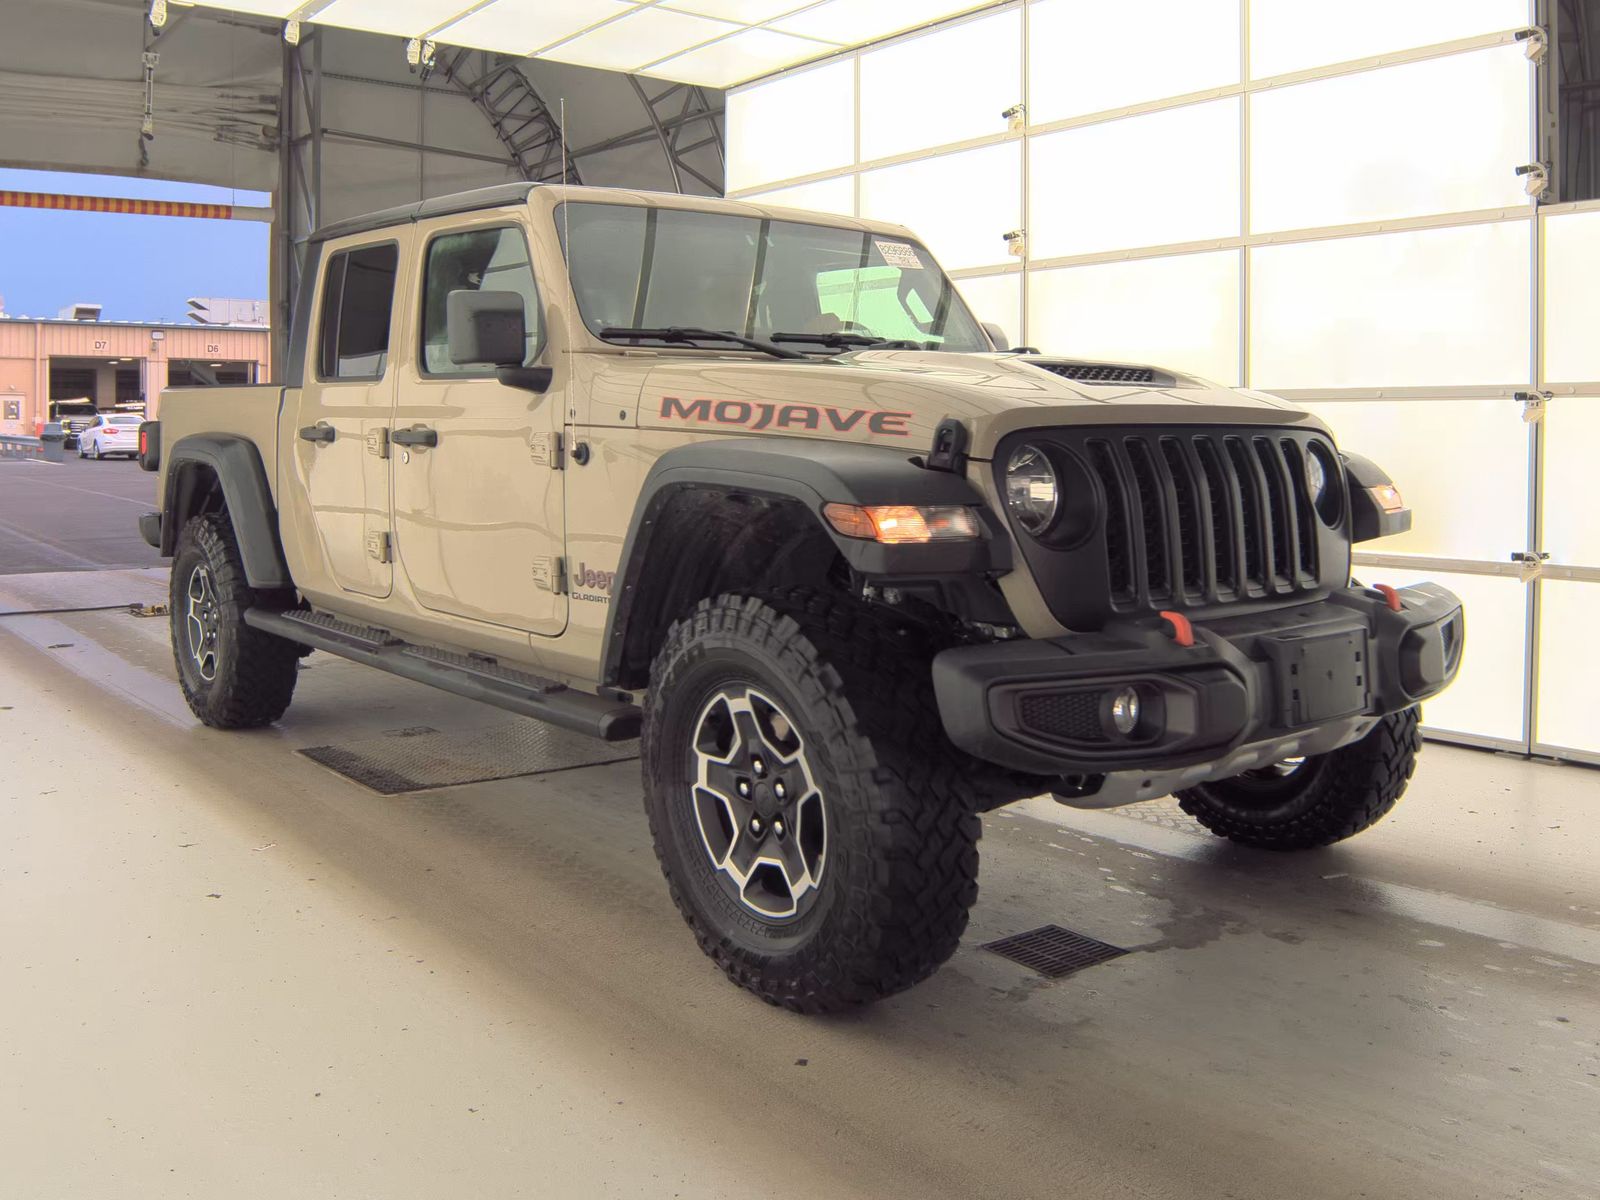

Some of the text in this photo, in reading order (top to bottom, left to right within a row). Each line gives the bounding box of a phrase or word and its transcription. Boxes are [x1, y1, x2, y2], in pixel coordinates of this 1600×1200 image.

[94, 341, 107, 350] D7
[207, 344, 219, 353] D6
[659, 396, 912, 437] MOJAVE
[571, 592, 608, 604] GLADIAT
